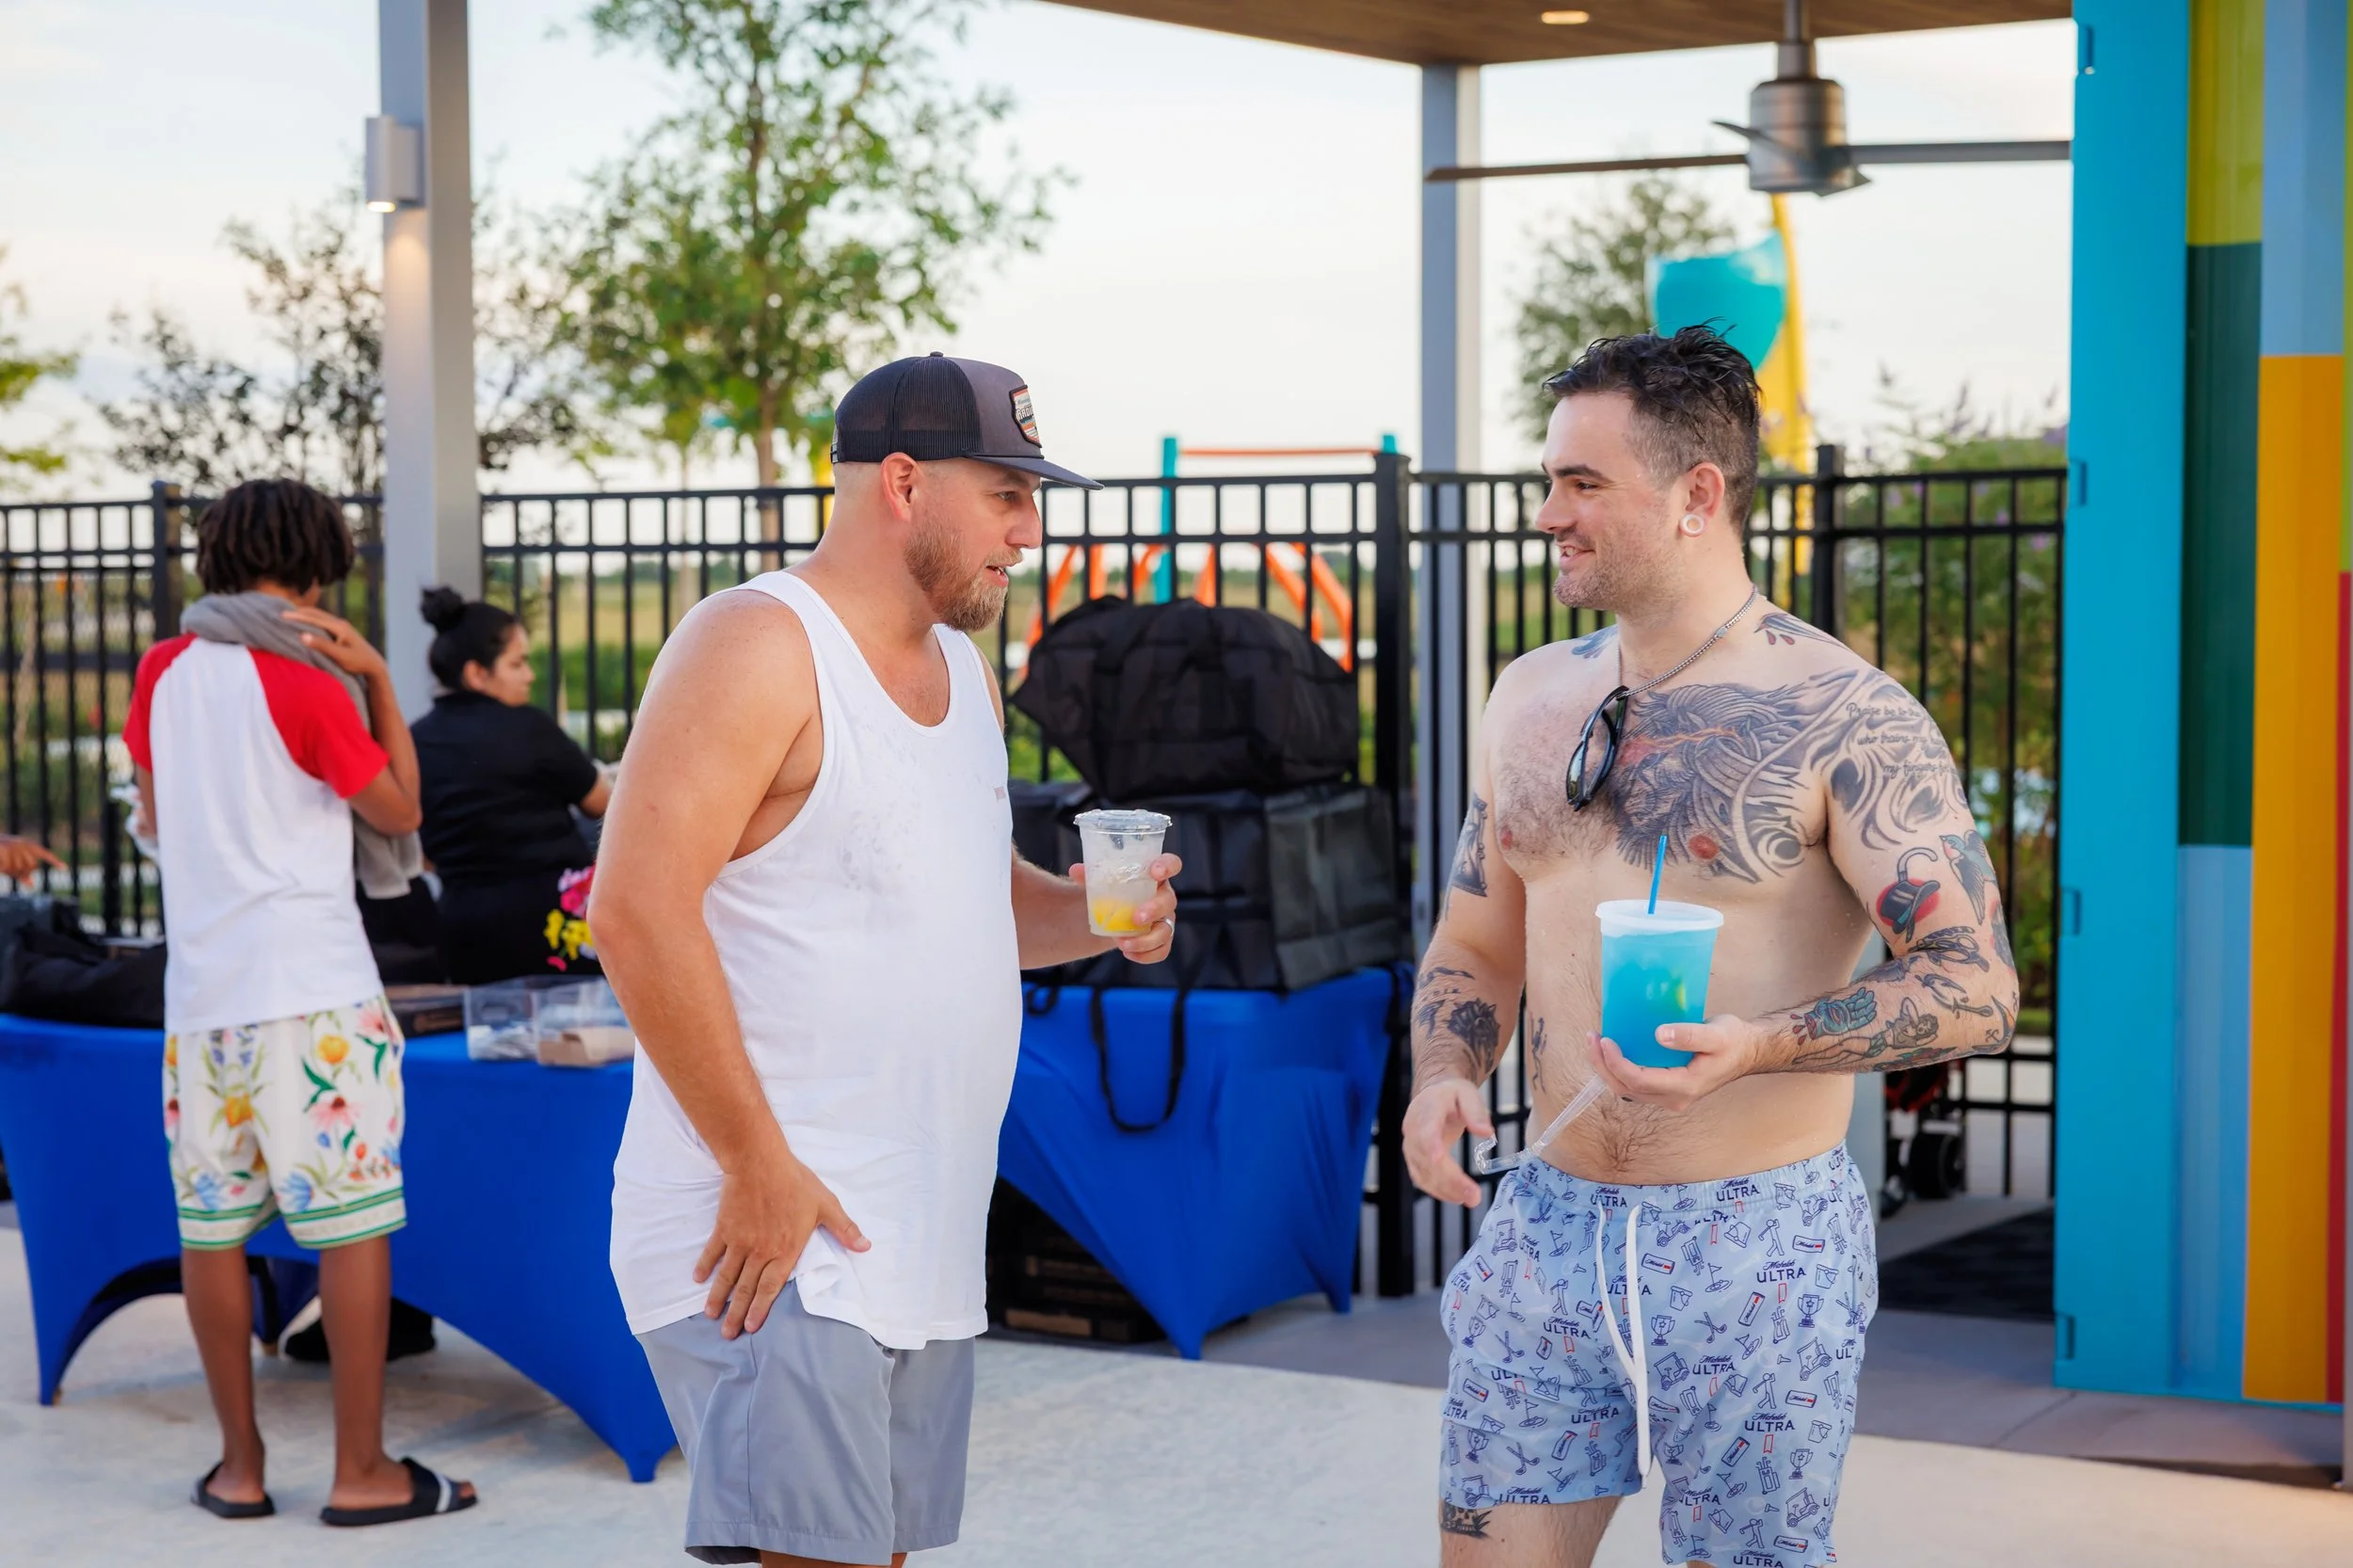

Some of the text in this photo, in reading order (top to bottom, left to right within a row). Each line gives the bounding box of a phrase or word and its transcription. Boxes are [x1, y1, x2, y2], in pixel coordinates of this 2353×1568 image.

[1721, 1177, 1750, 1190] Michelob
[1716, 1184, 1760, 1202] ULTRA
[1591, 1193, 1628, 1208] ULTRA
[1763, 1259, 1797, 1271] Michelob
[1756, 1268, 1807, 1283] ULTRA
[1547, 1317, 1580, 1327] Michelob
[1543, 1321, 1592, 1339] ULTRA
[1698, 1354, 1732, 1364] Michelob
[1692, 1363, 1736, 1375] ULTRA
[1571, 1407, 1620, 1424] ULTRA
[1751, 1412, 1786, 1420] Michelob
[1744, 1419, 1796, 1432] ULTRA
[1733, 1555, 1784, 1568] ULTRA
